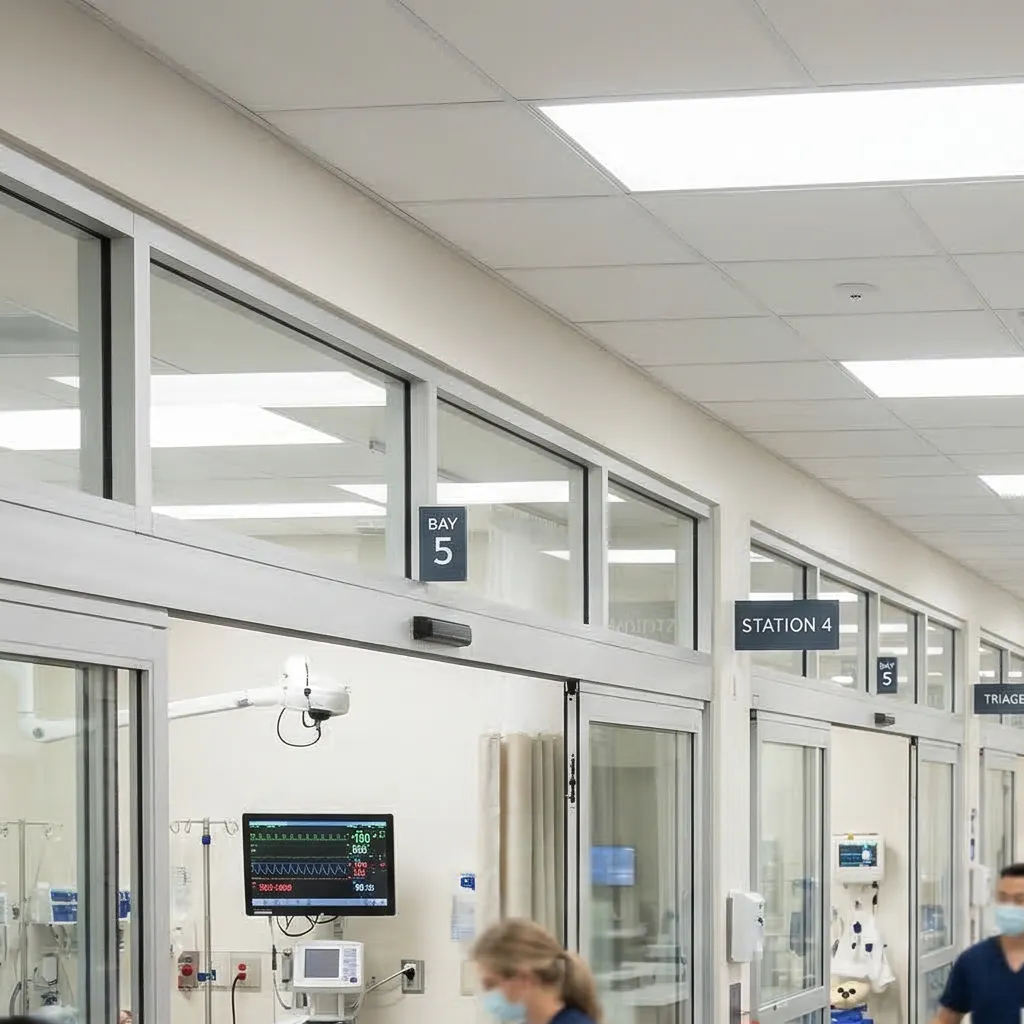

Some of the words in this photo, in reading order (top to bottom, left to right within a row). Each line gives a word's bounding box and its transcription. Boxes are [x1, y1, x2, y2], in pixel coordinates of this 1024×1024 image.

[428, 517, 459, 531] BAY
[433, 537, 453, 566] 5
[742, 616, 816, 633] STATION
[821, 616, 833, 633] 4
[882, 671, 893, 686] 5
